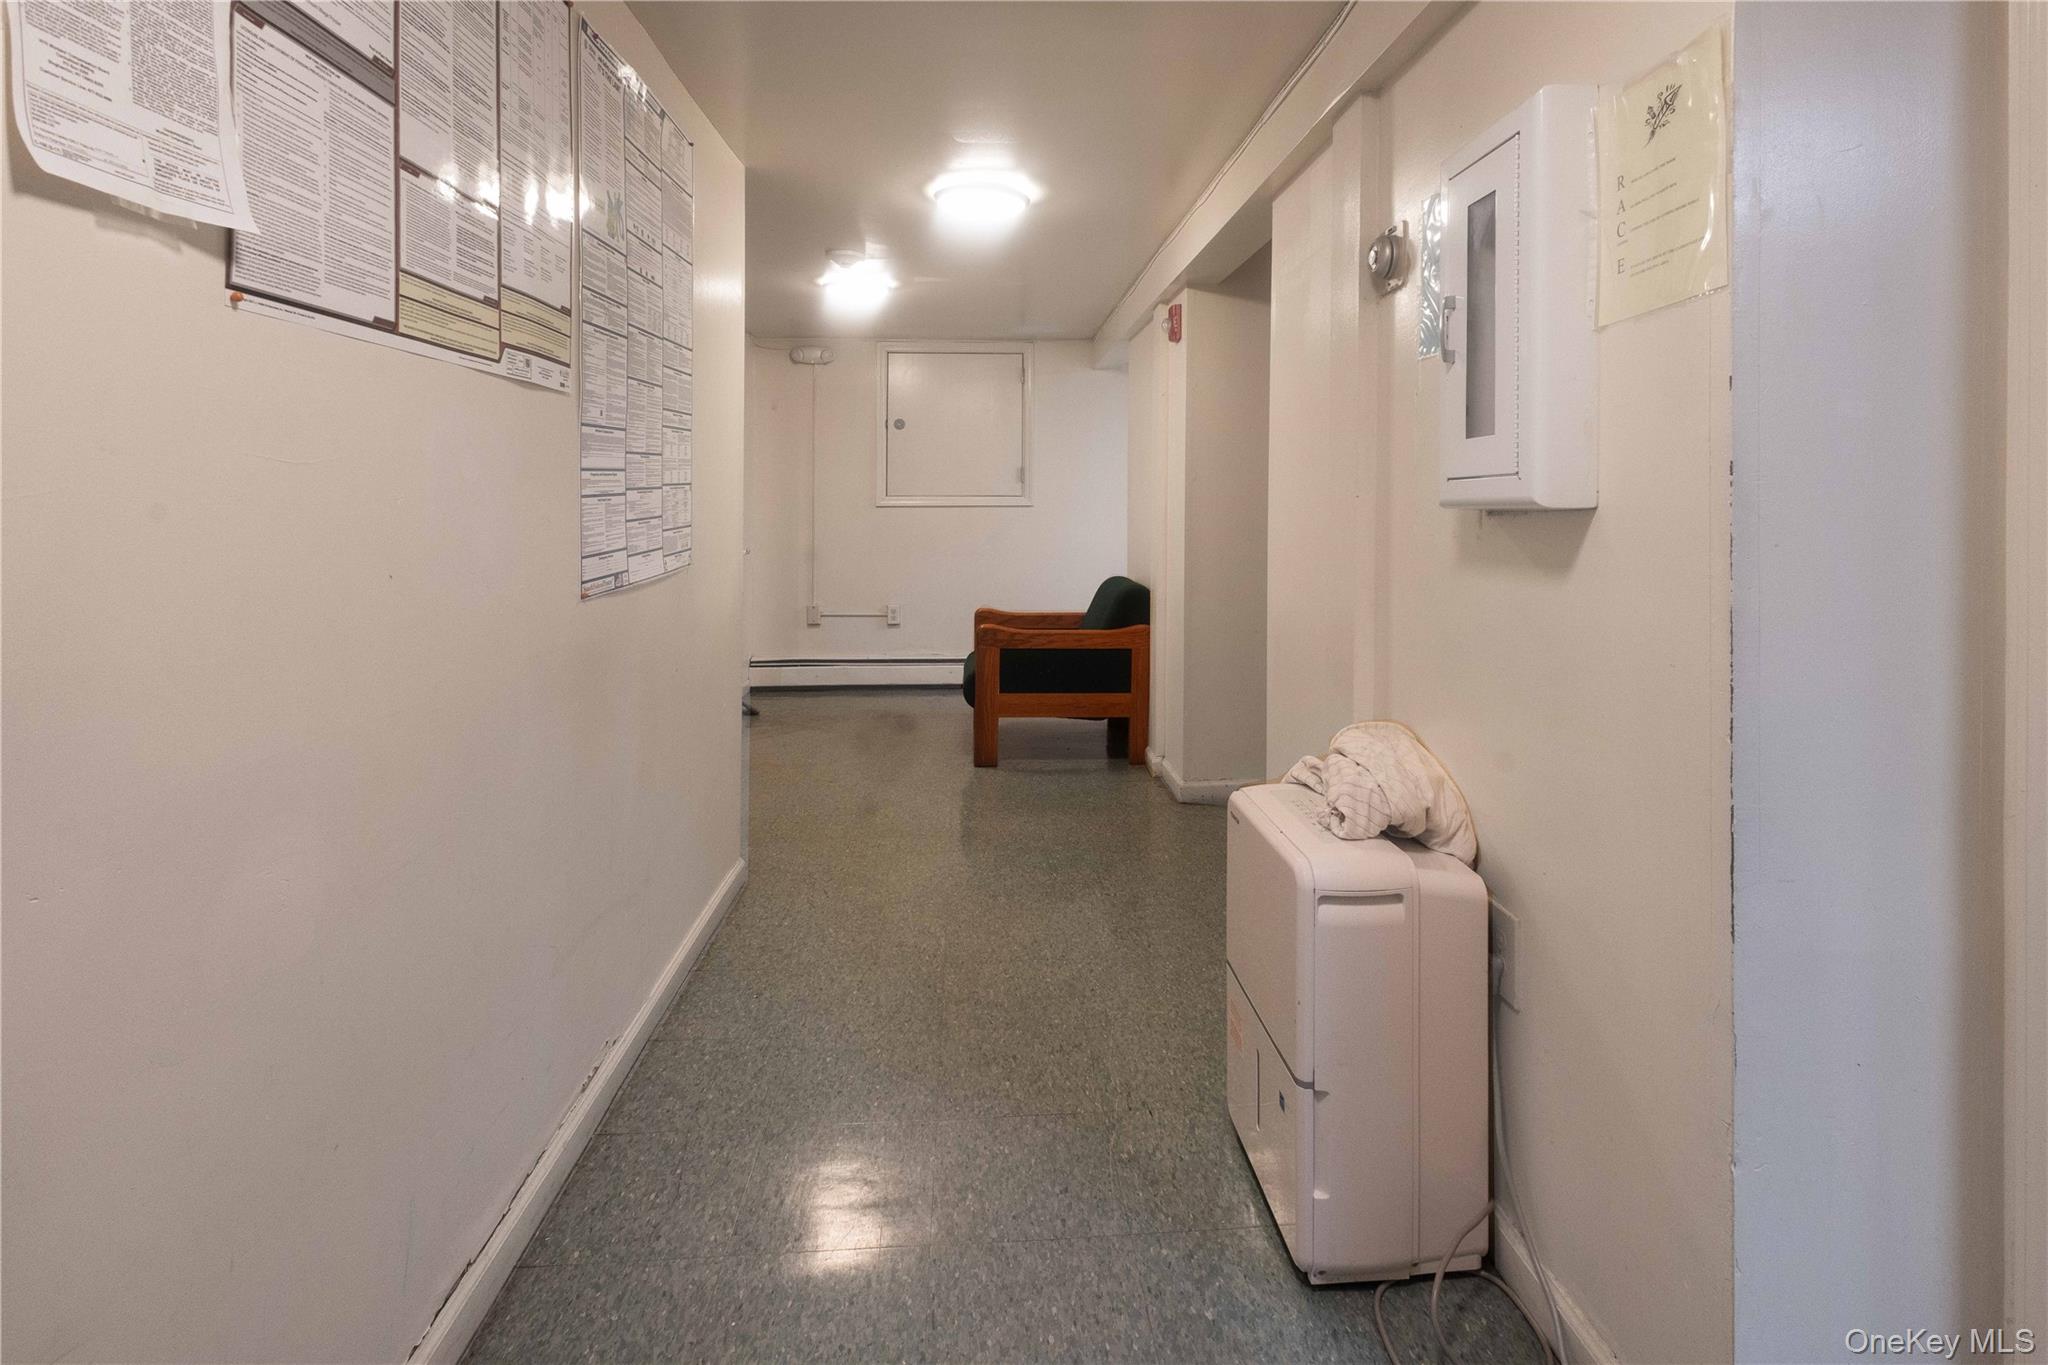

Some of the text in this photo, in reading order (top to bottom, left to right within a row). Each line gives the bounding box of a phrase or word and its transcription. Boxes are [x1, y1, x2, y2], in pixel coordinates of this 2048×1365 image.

[1617, 175, 1625, 191] R
[1617, 200, 1625, 215] A
[1617, 221, 1626, 238] C
[1617, 258, 1625, 274] E
